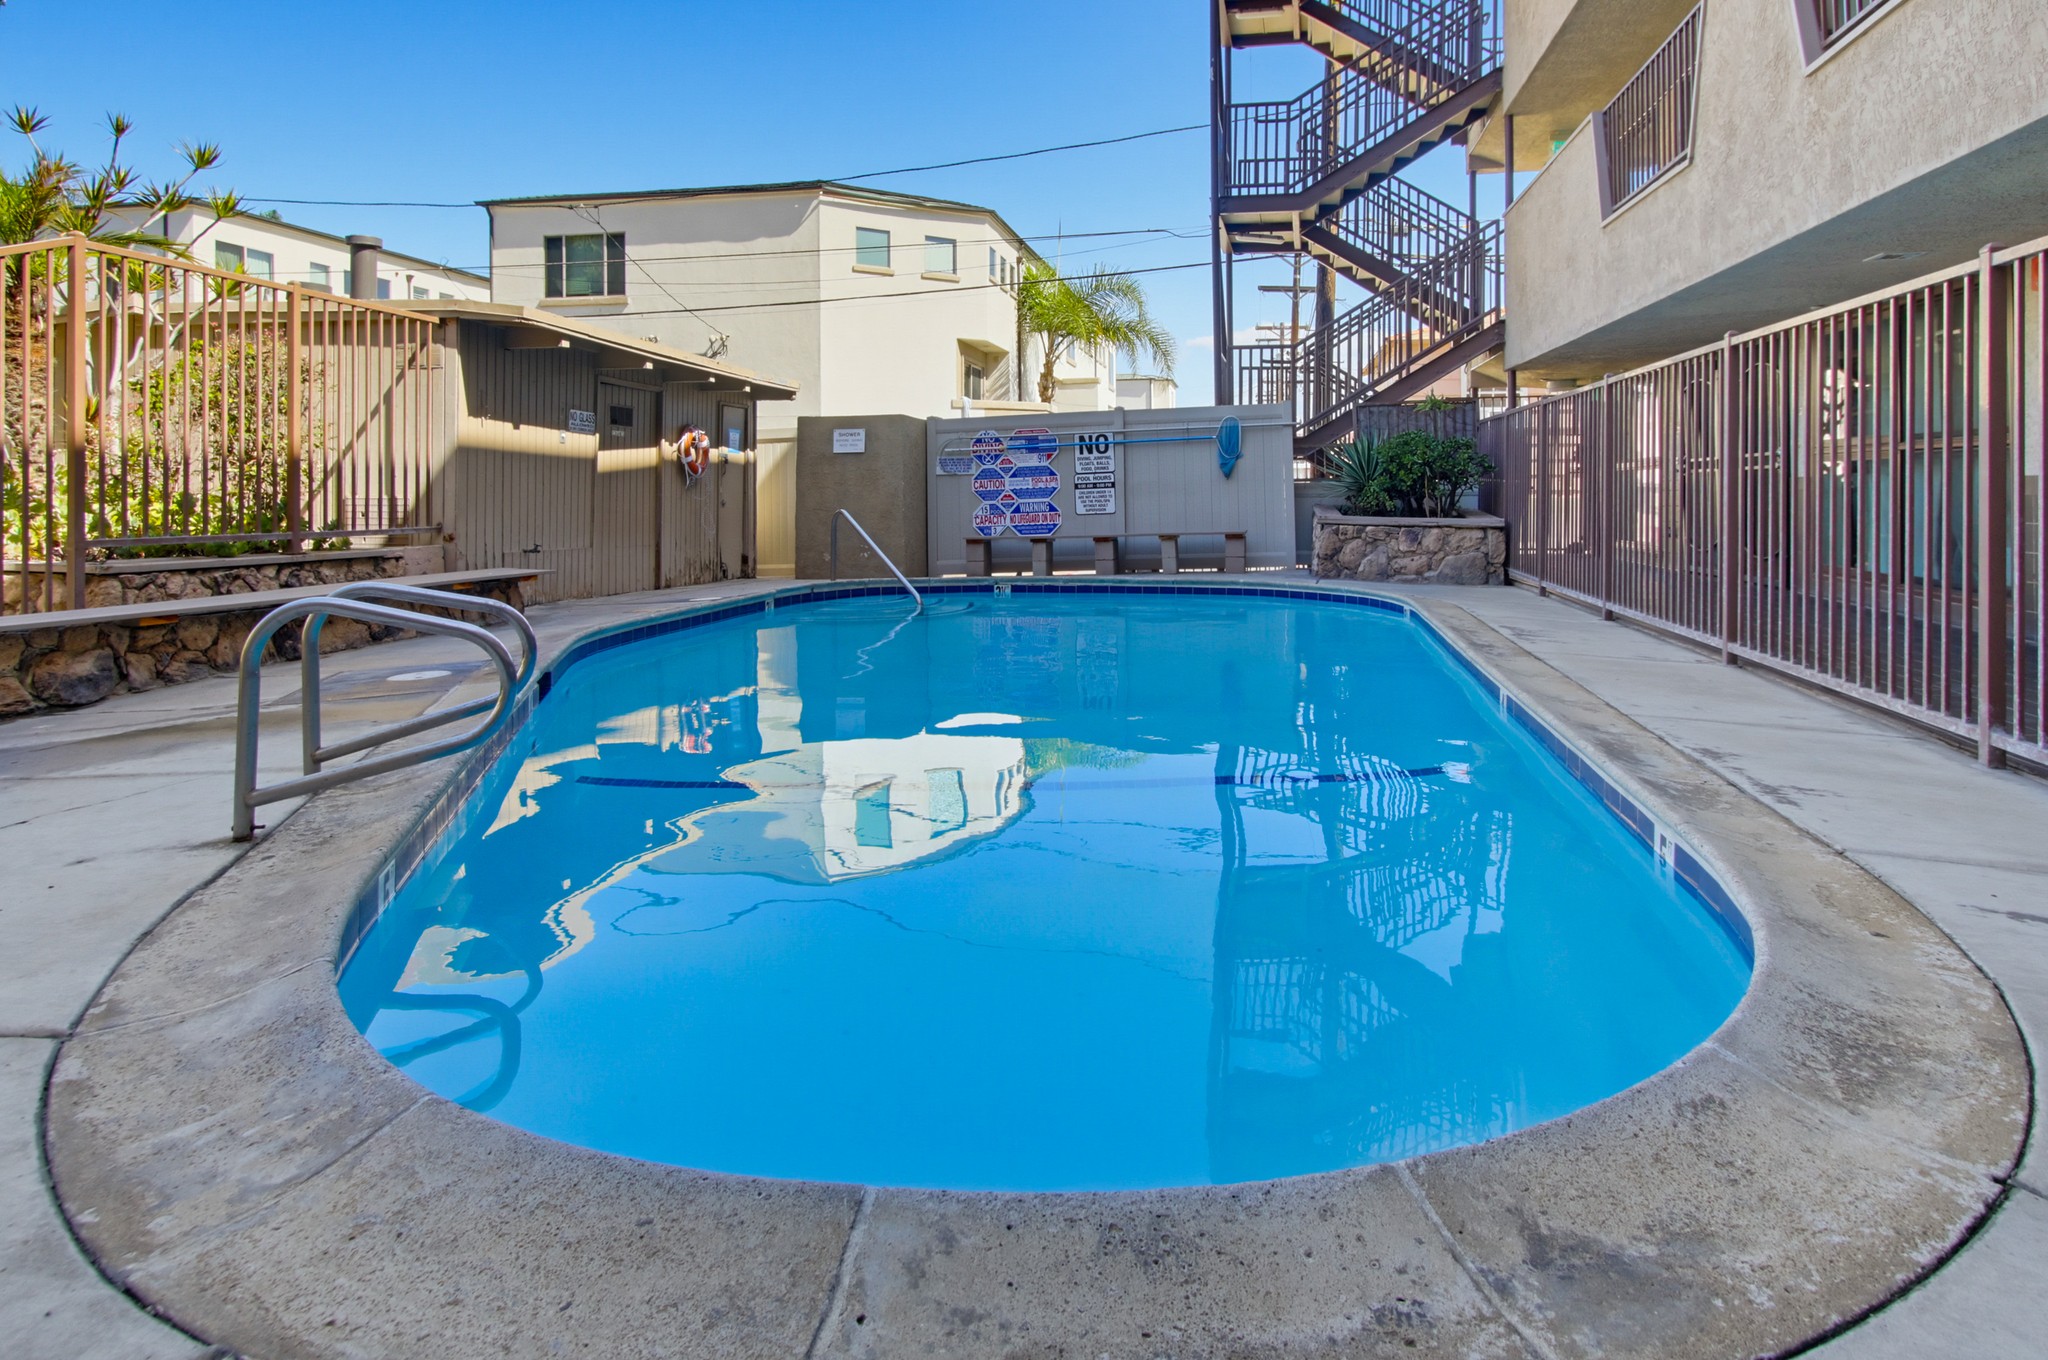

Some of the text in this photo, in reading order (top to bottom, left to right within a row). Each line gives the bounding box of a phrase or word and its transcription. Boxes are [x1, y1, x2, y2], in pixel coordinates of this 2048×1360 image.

[972, 442, 1004, 454] DIVING
[1078, 434, 1110, 454] NO
[974, 480, 1005, 490] CAUTION
[1020, 503, 1049, 512] WARNING
[974, 515, 1007, 525] CAPACITY
[1010, 513, 1060, 524] NO LIFEGUARD ON DUTY
